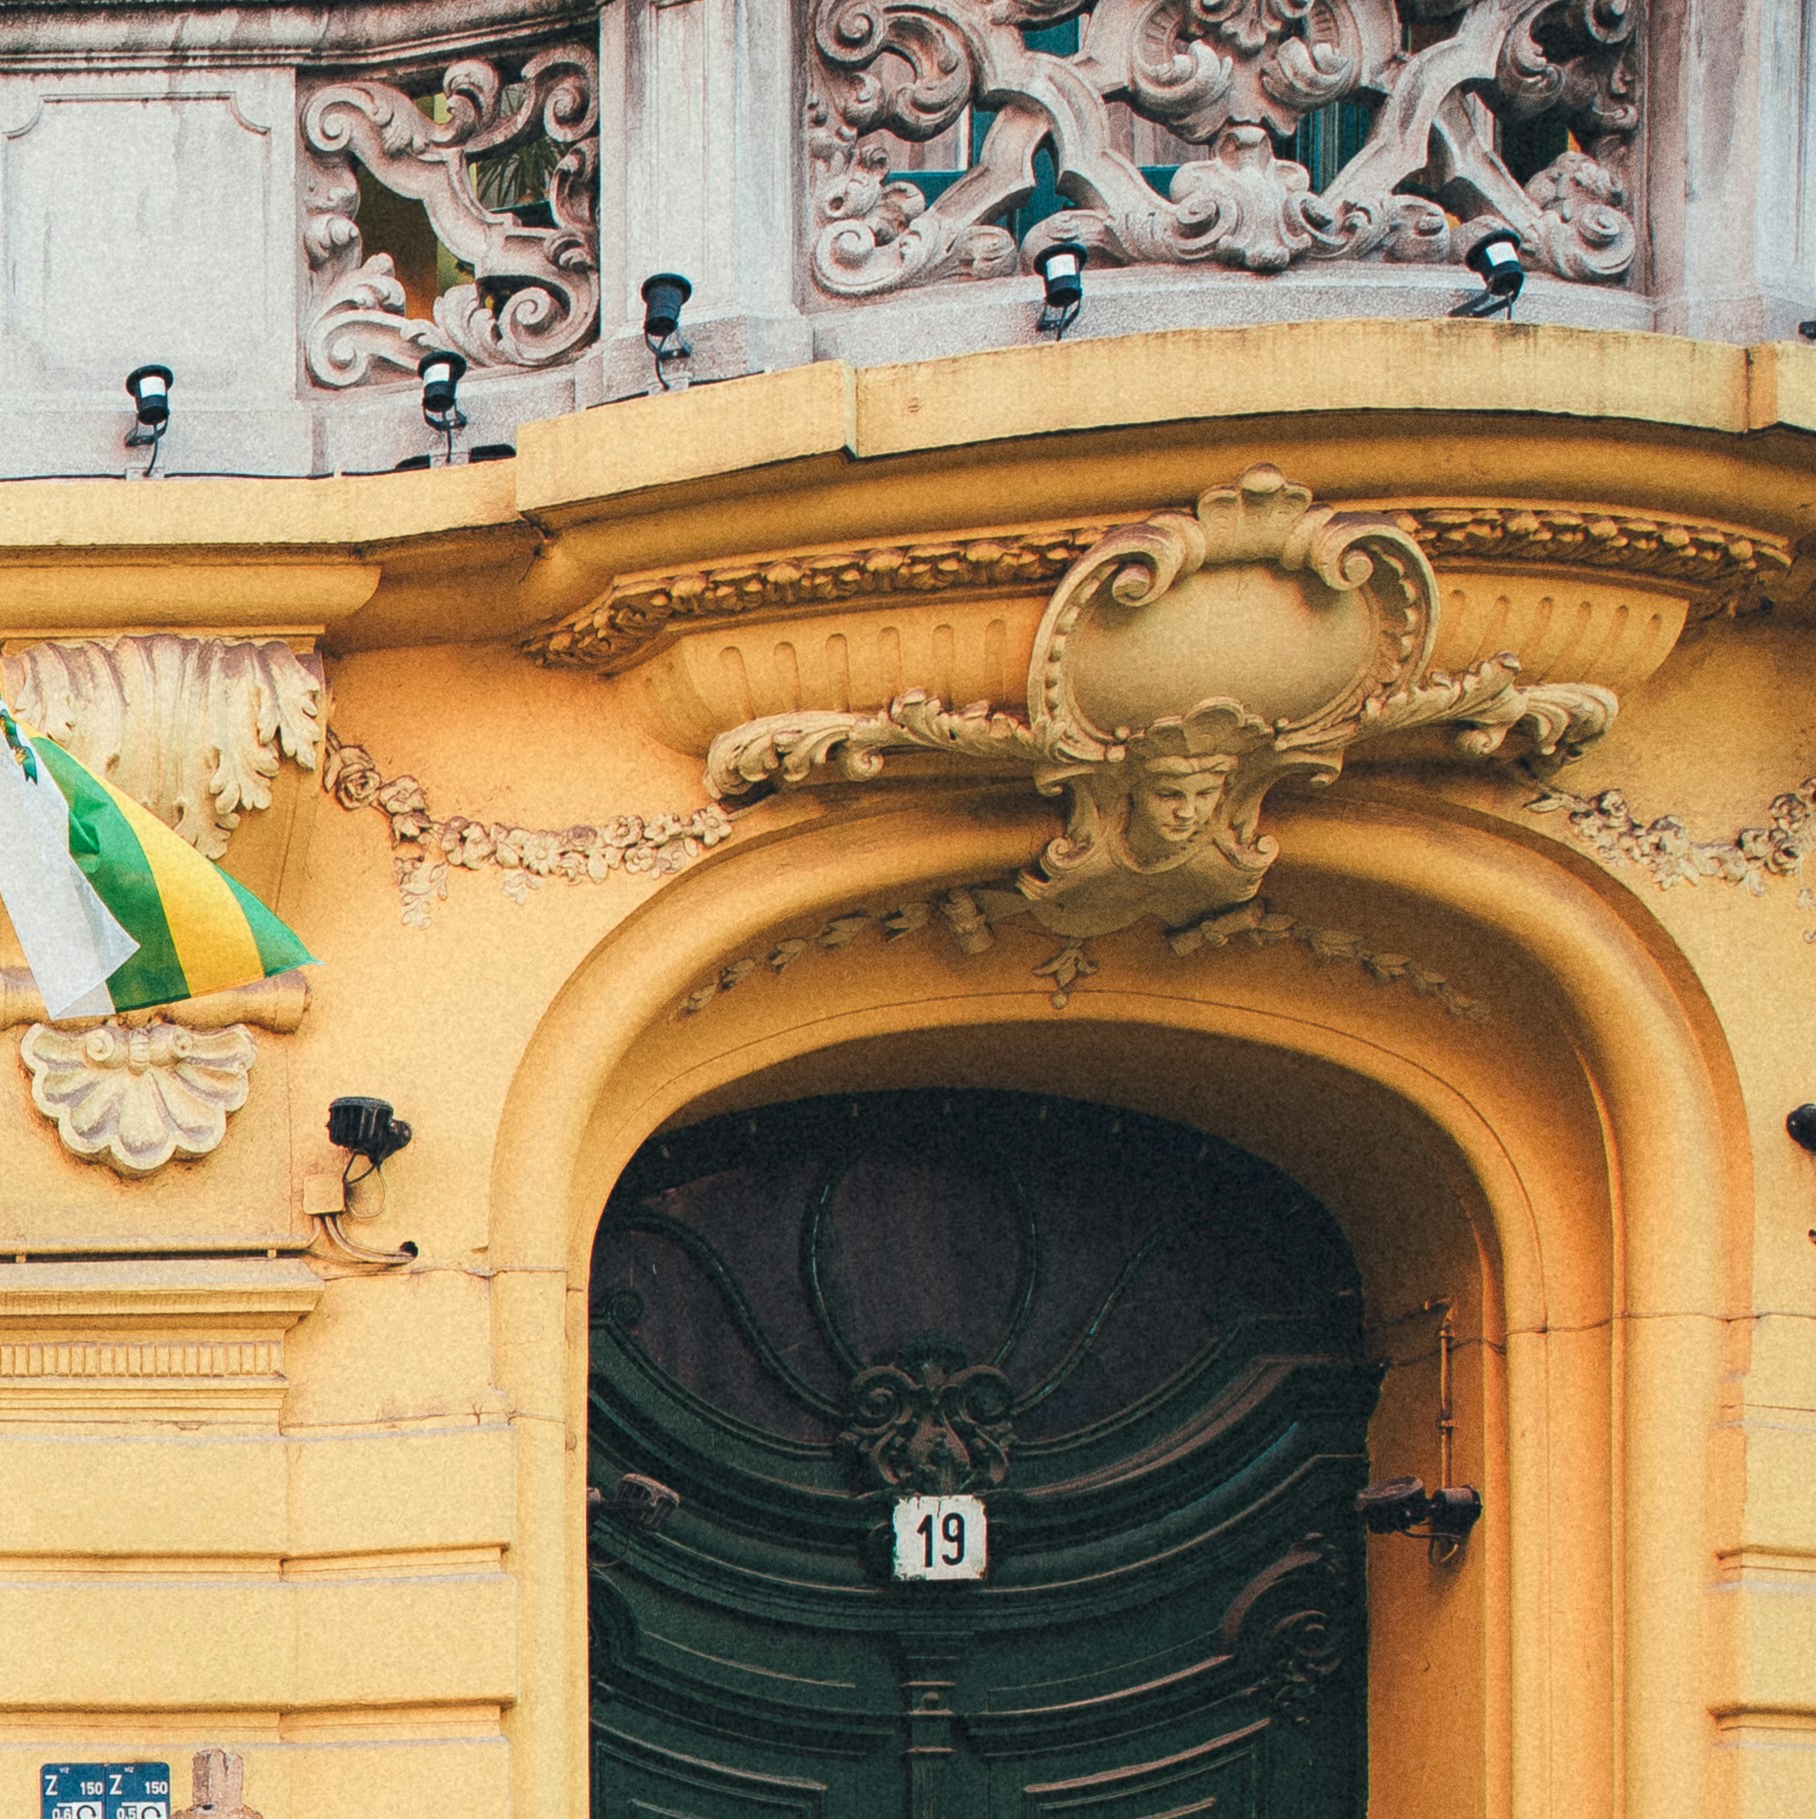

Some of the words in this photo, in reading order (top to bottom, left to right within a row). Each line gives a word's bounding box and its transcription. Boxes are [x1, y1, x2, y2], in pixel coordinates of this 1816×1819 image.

[916, 1512, 965, 1568] 19
[45, 1775, 58, 1796] Z
[80, 1782, 103, 1796] 150
[109, 1774, 123, 1795] Z
[145, 1781, 168, 1795] 150
